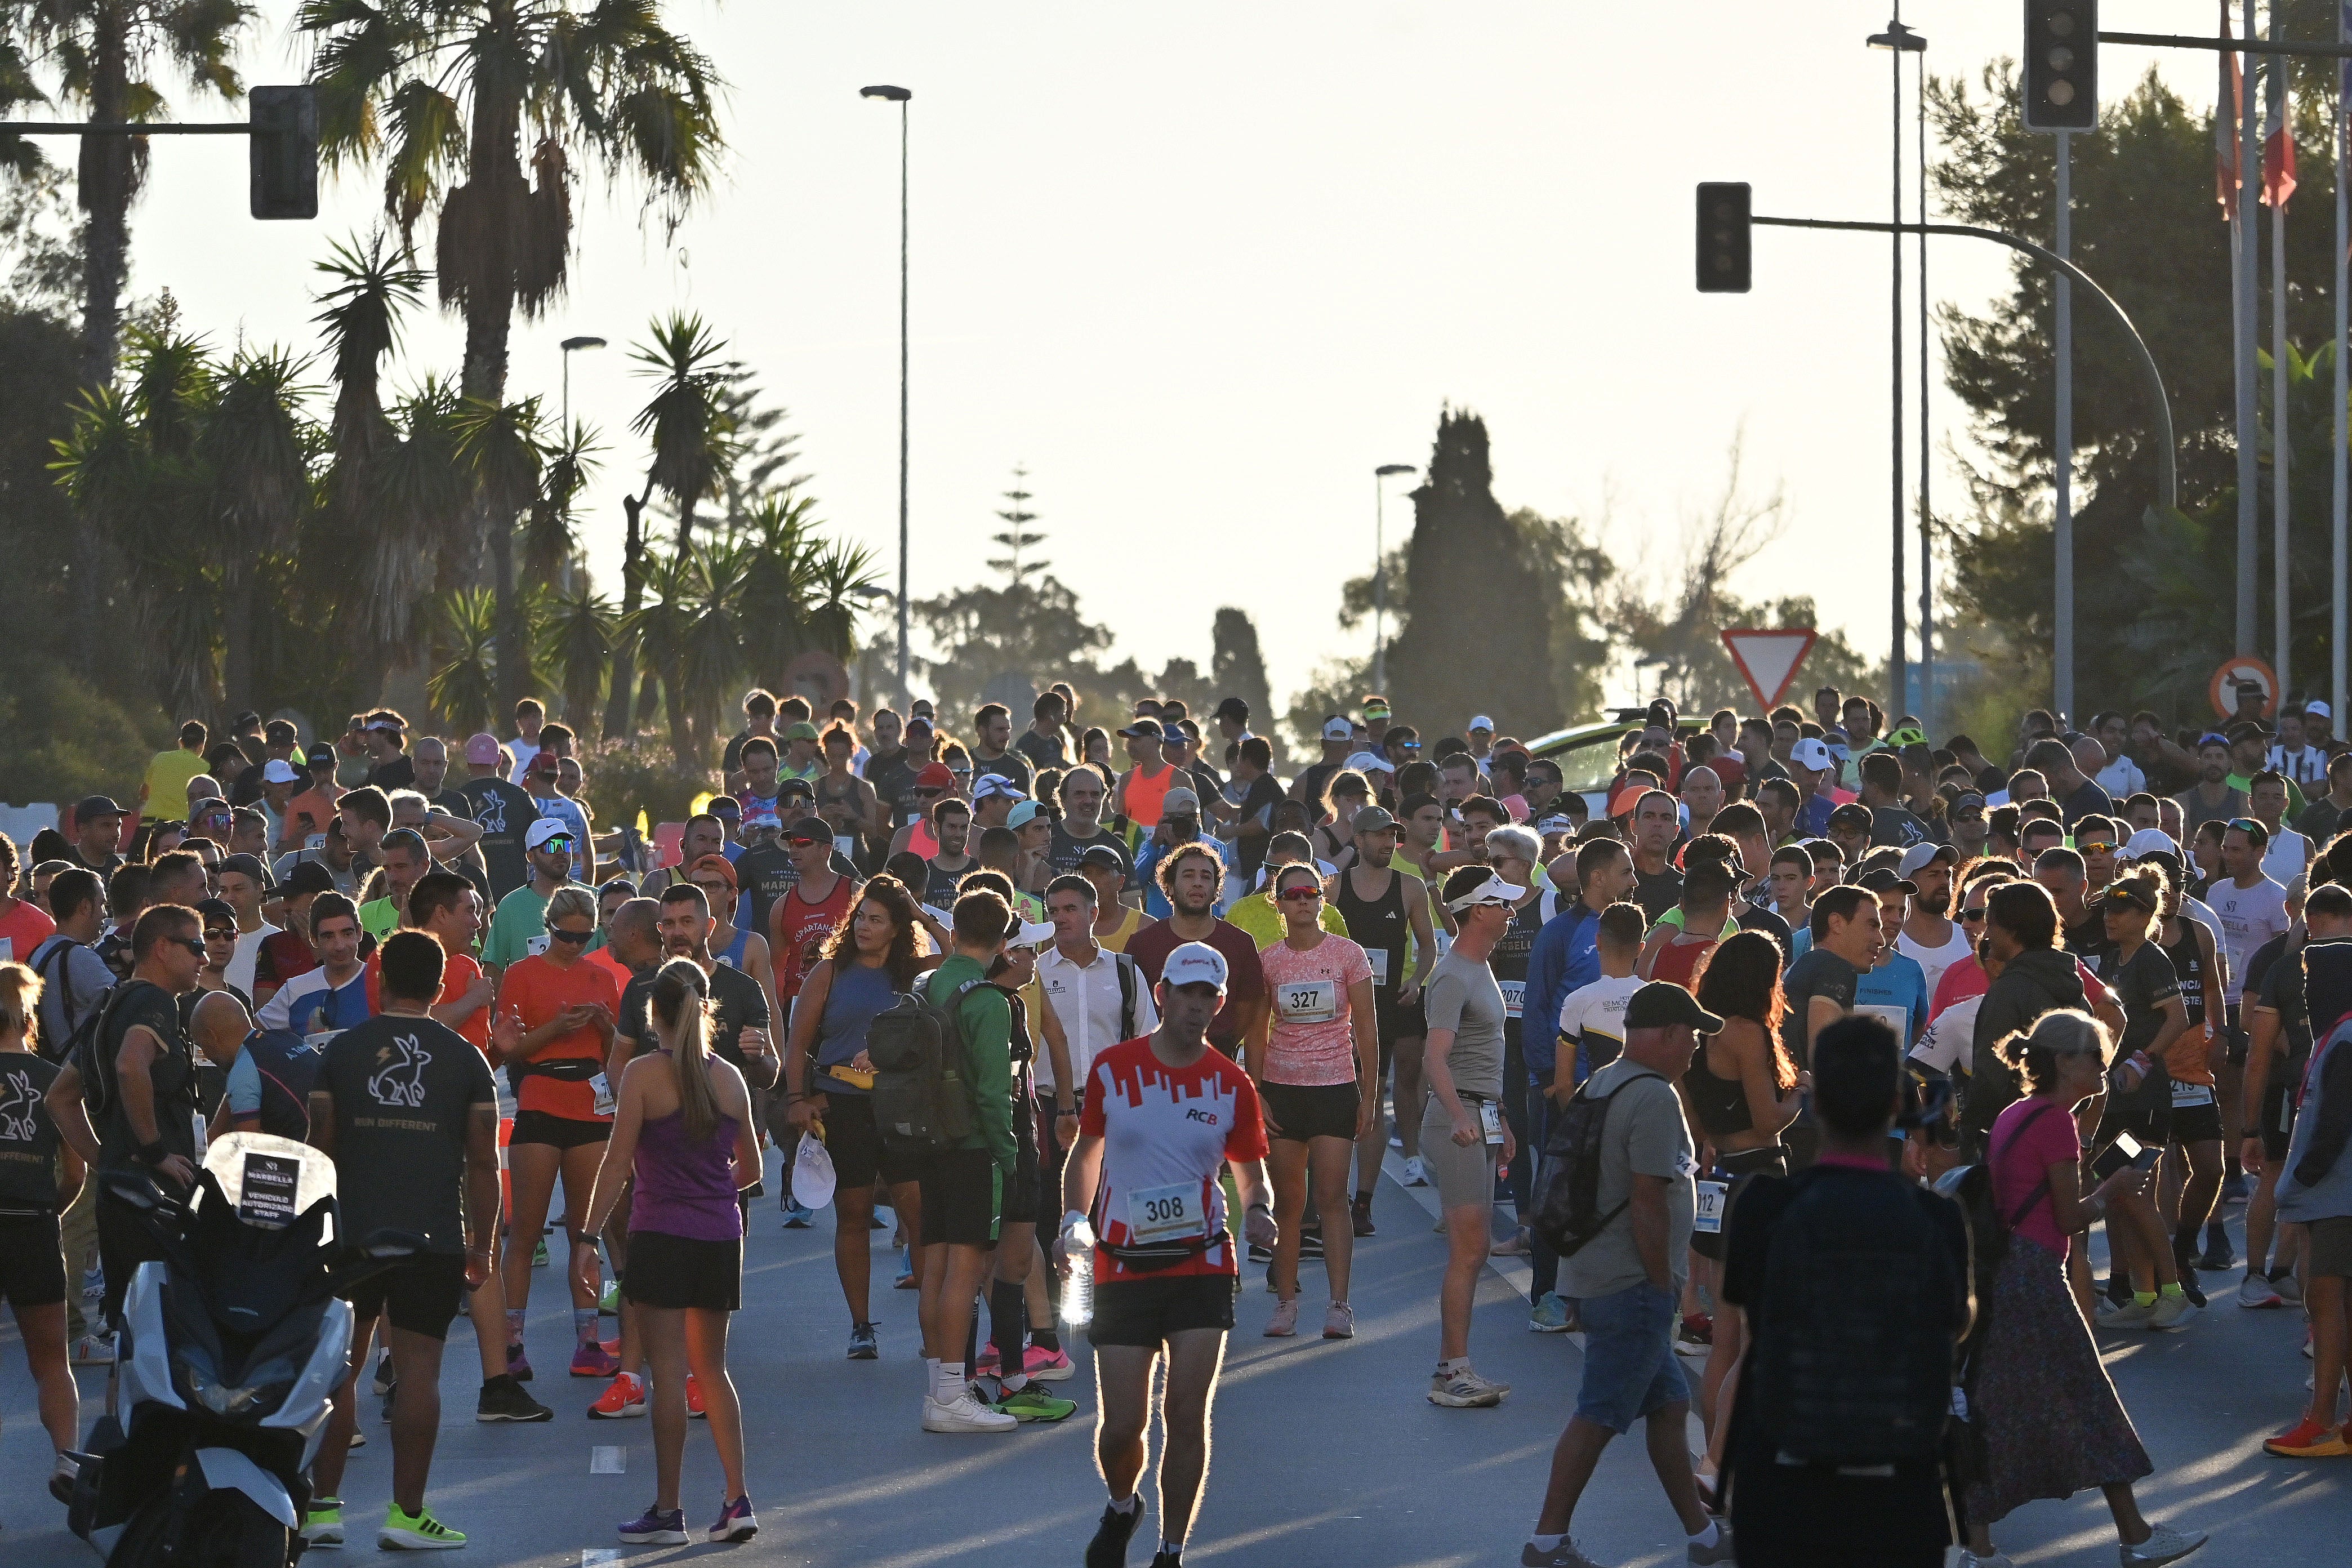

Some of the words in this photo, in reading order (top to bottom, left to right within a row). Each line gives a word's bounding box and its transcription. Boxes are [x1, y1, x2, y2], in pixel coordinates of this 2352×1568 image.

[1291, 991, 1318, 1009] 327
[1186, 1108, 1217, 1126] RCB
[248, 1171, 293, 1184] MARBELLA
[241, 1199, 293, 1213] AUTORIZADO
[253, 1209, 280, 1218] STAFF
[1146, 1197, 1183, 1222] 308
